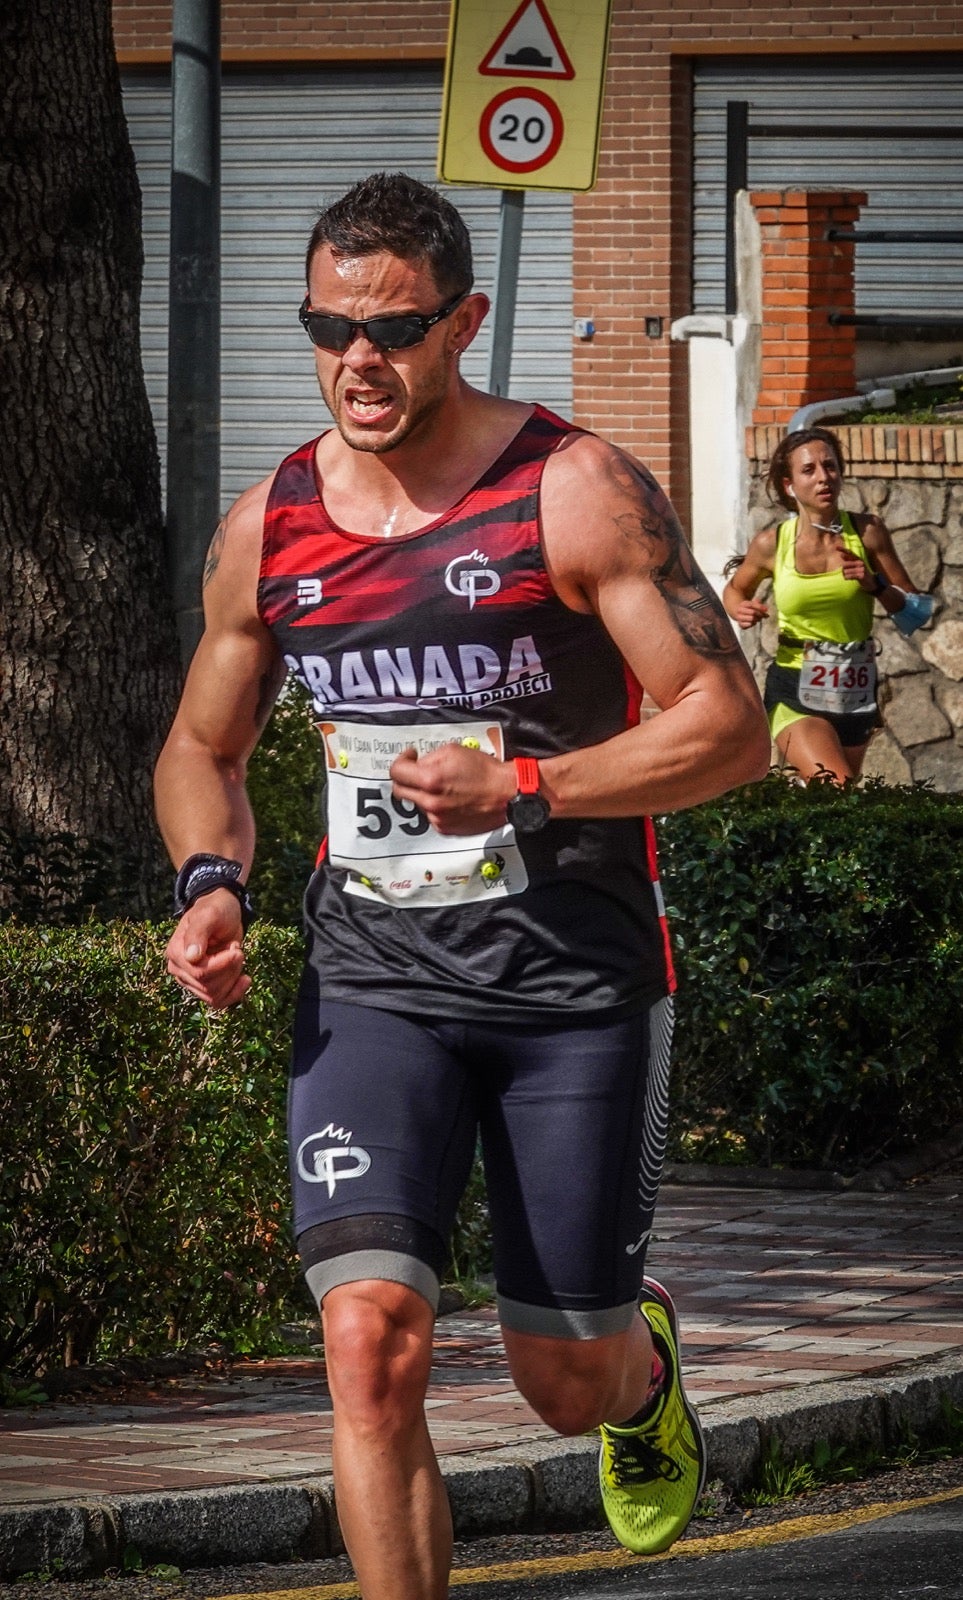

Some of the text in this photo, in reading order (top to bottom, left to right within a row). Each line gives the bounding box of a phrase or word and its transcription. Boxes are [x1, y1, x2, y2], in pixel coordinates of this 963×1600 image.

[498, 114, 545, 144] 20
[480, 674, 550, 706] PROJECT
[809, 664, 869, 689] 2136
